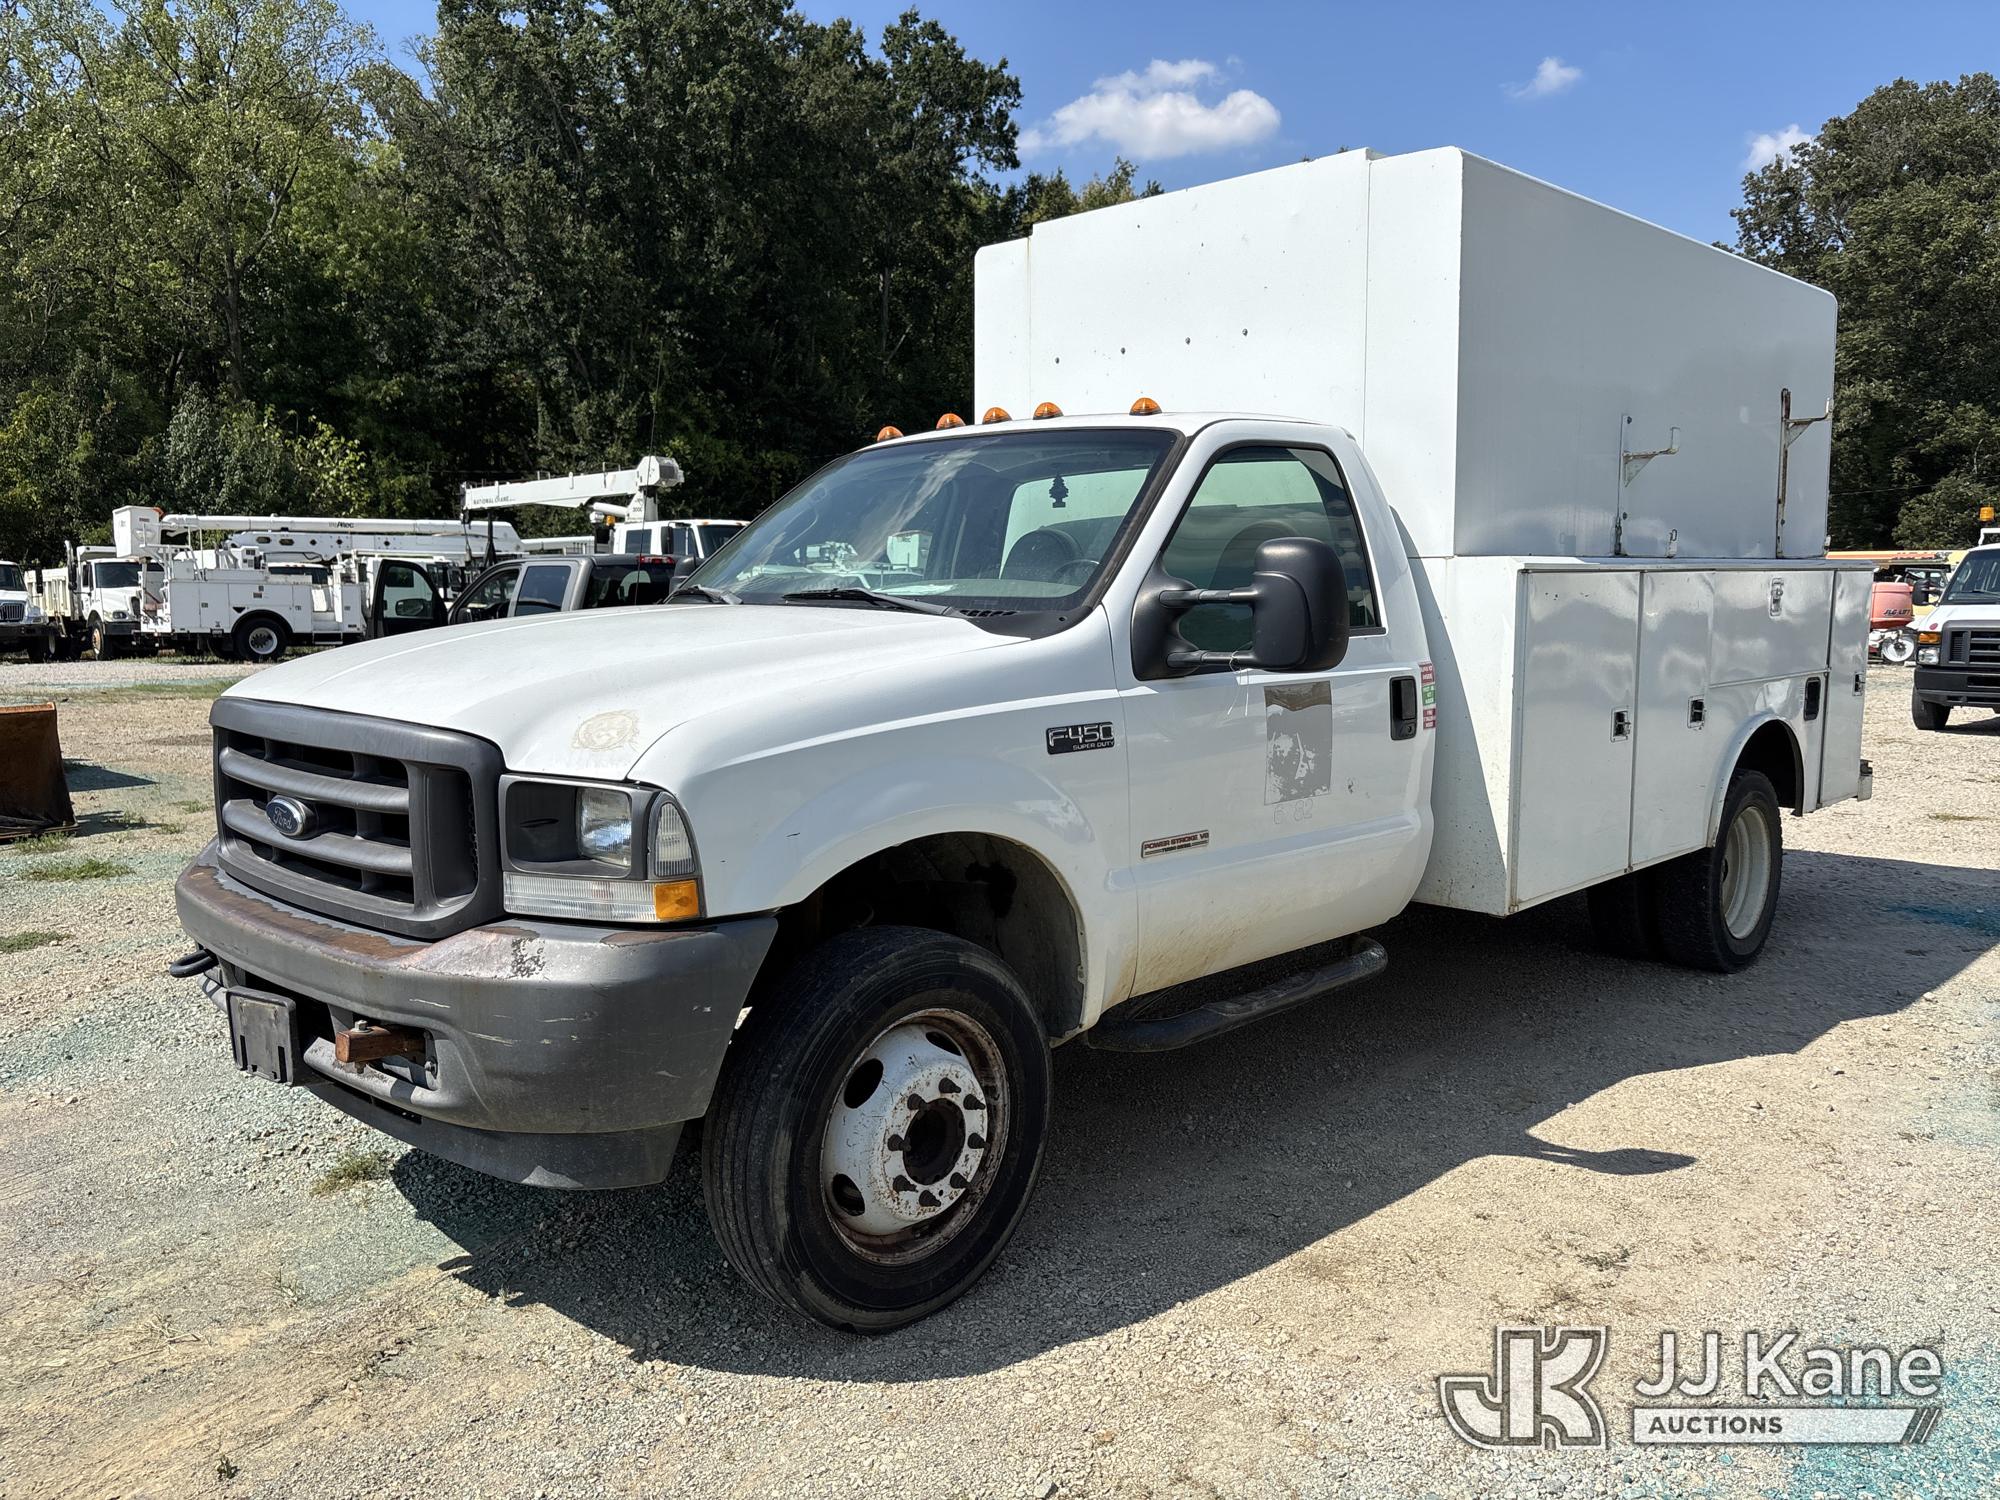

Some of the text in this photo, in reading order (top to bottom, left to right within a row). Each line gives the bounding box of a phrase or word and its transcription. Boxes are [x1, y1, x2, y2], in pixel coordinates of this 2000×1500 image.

[1072, 740, 1115, 751] SUPER DUTY
[272, 806, 294, 830] Ford
[1143, 839, 1170, 851] POWER
[1170, 834, 1199, 846] STROKE
